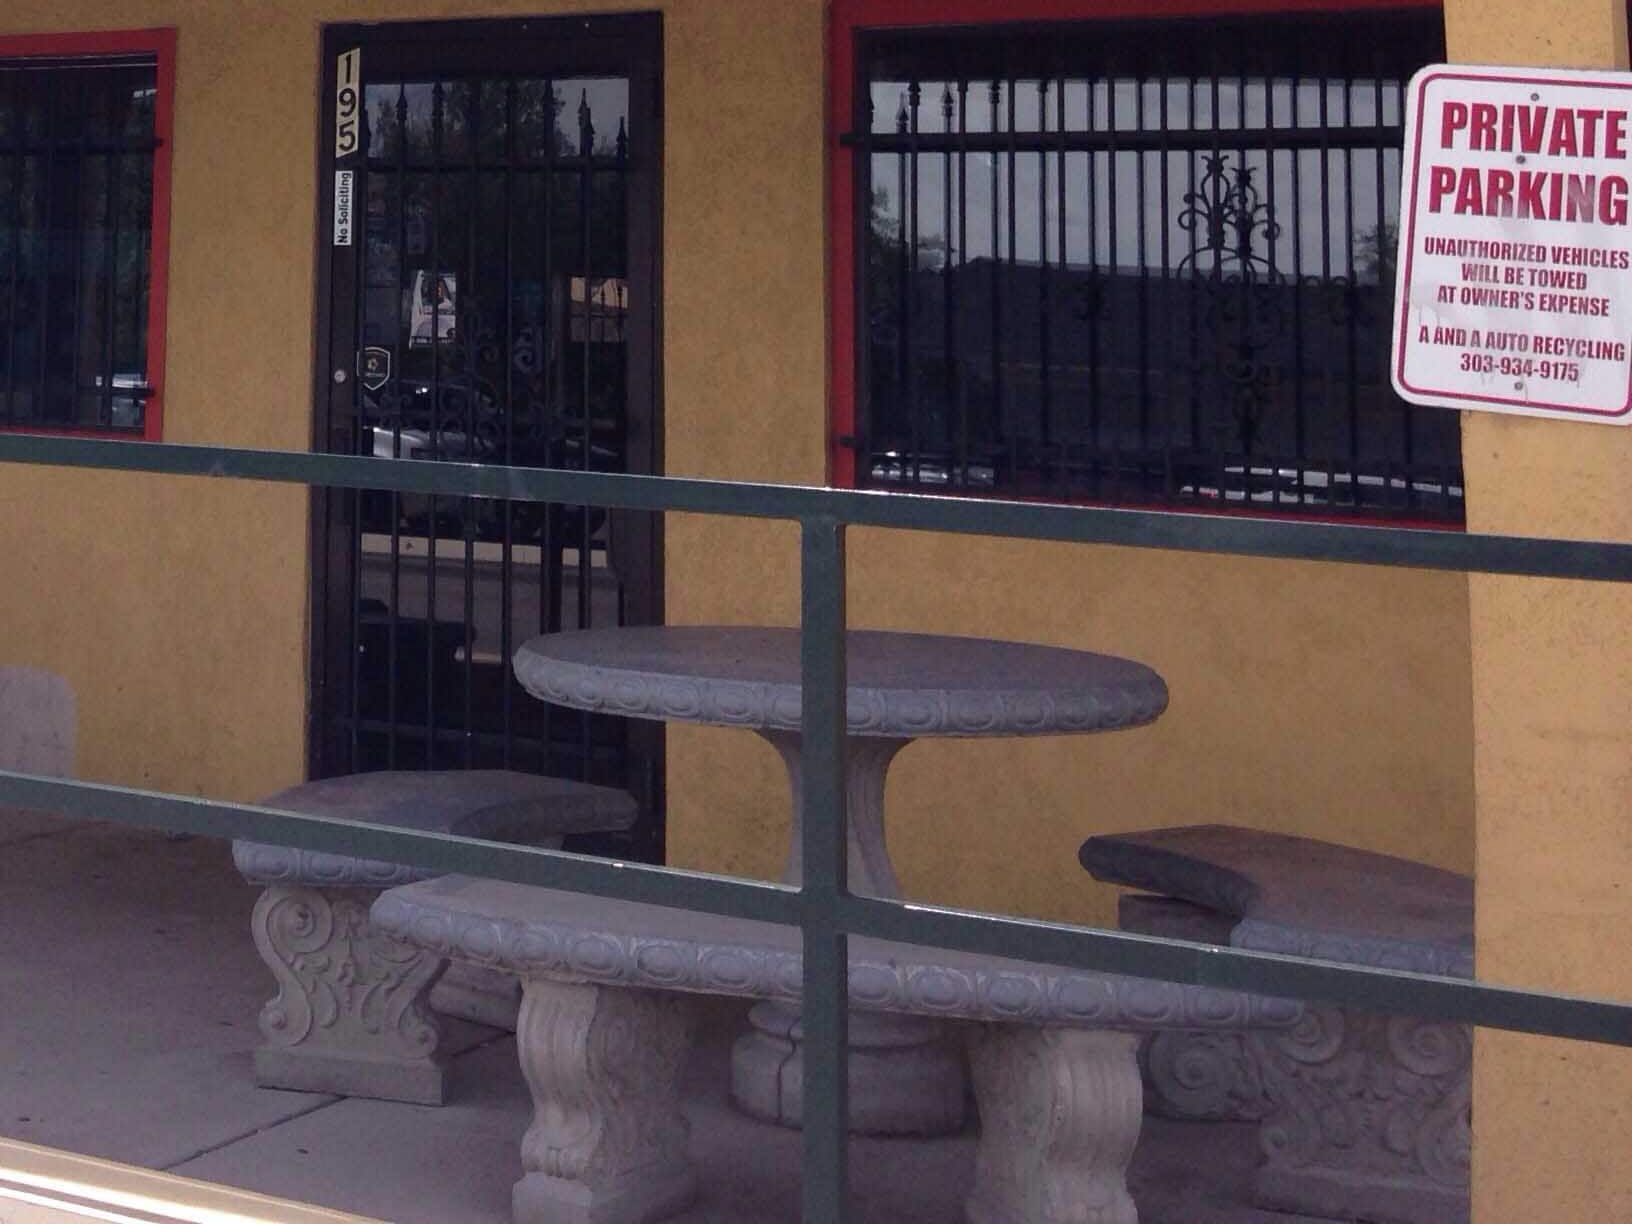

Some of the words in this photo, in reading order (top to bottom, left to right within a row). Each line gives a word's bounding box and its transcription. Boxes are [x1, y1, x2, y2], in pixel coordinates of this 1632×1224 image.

[338, 54, 357, 152] 195
[1440, 101, 1627, 160] PRIVATE
[1428, 165, 1629, 226] PARKING
[336, 227, 349, 244] No
[1424, 237, 1547, 263] UNAUTHORIZED
[1551, 246, 1629, 269] VEHICLES
[1462, 263, 1500, 284] WILL
[1504, 266, 1524, 285] BE
[1528, 269, 1587, 290] TOWED
[1437, 285, 1456, 304] AT
[1461, 287, 1535, 310] OWNER'S
[1539, 294, 1610, 317] EXPENSE
[1419, 325, 1429, 343] A
[1433, 327, 1466, 346] AND
[1470, 330, 1481, 348] A
[1485, 331, 1529, 352] AUTO
[1533, 335, 1625, 361] RECYCLING
[1461, 353, 1579, 382] 303-934-9175
